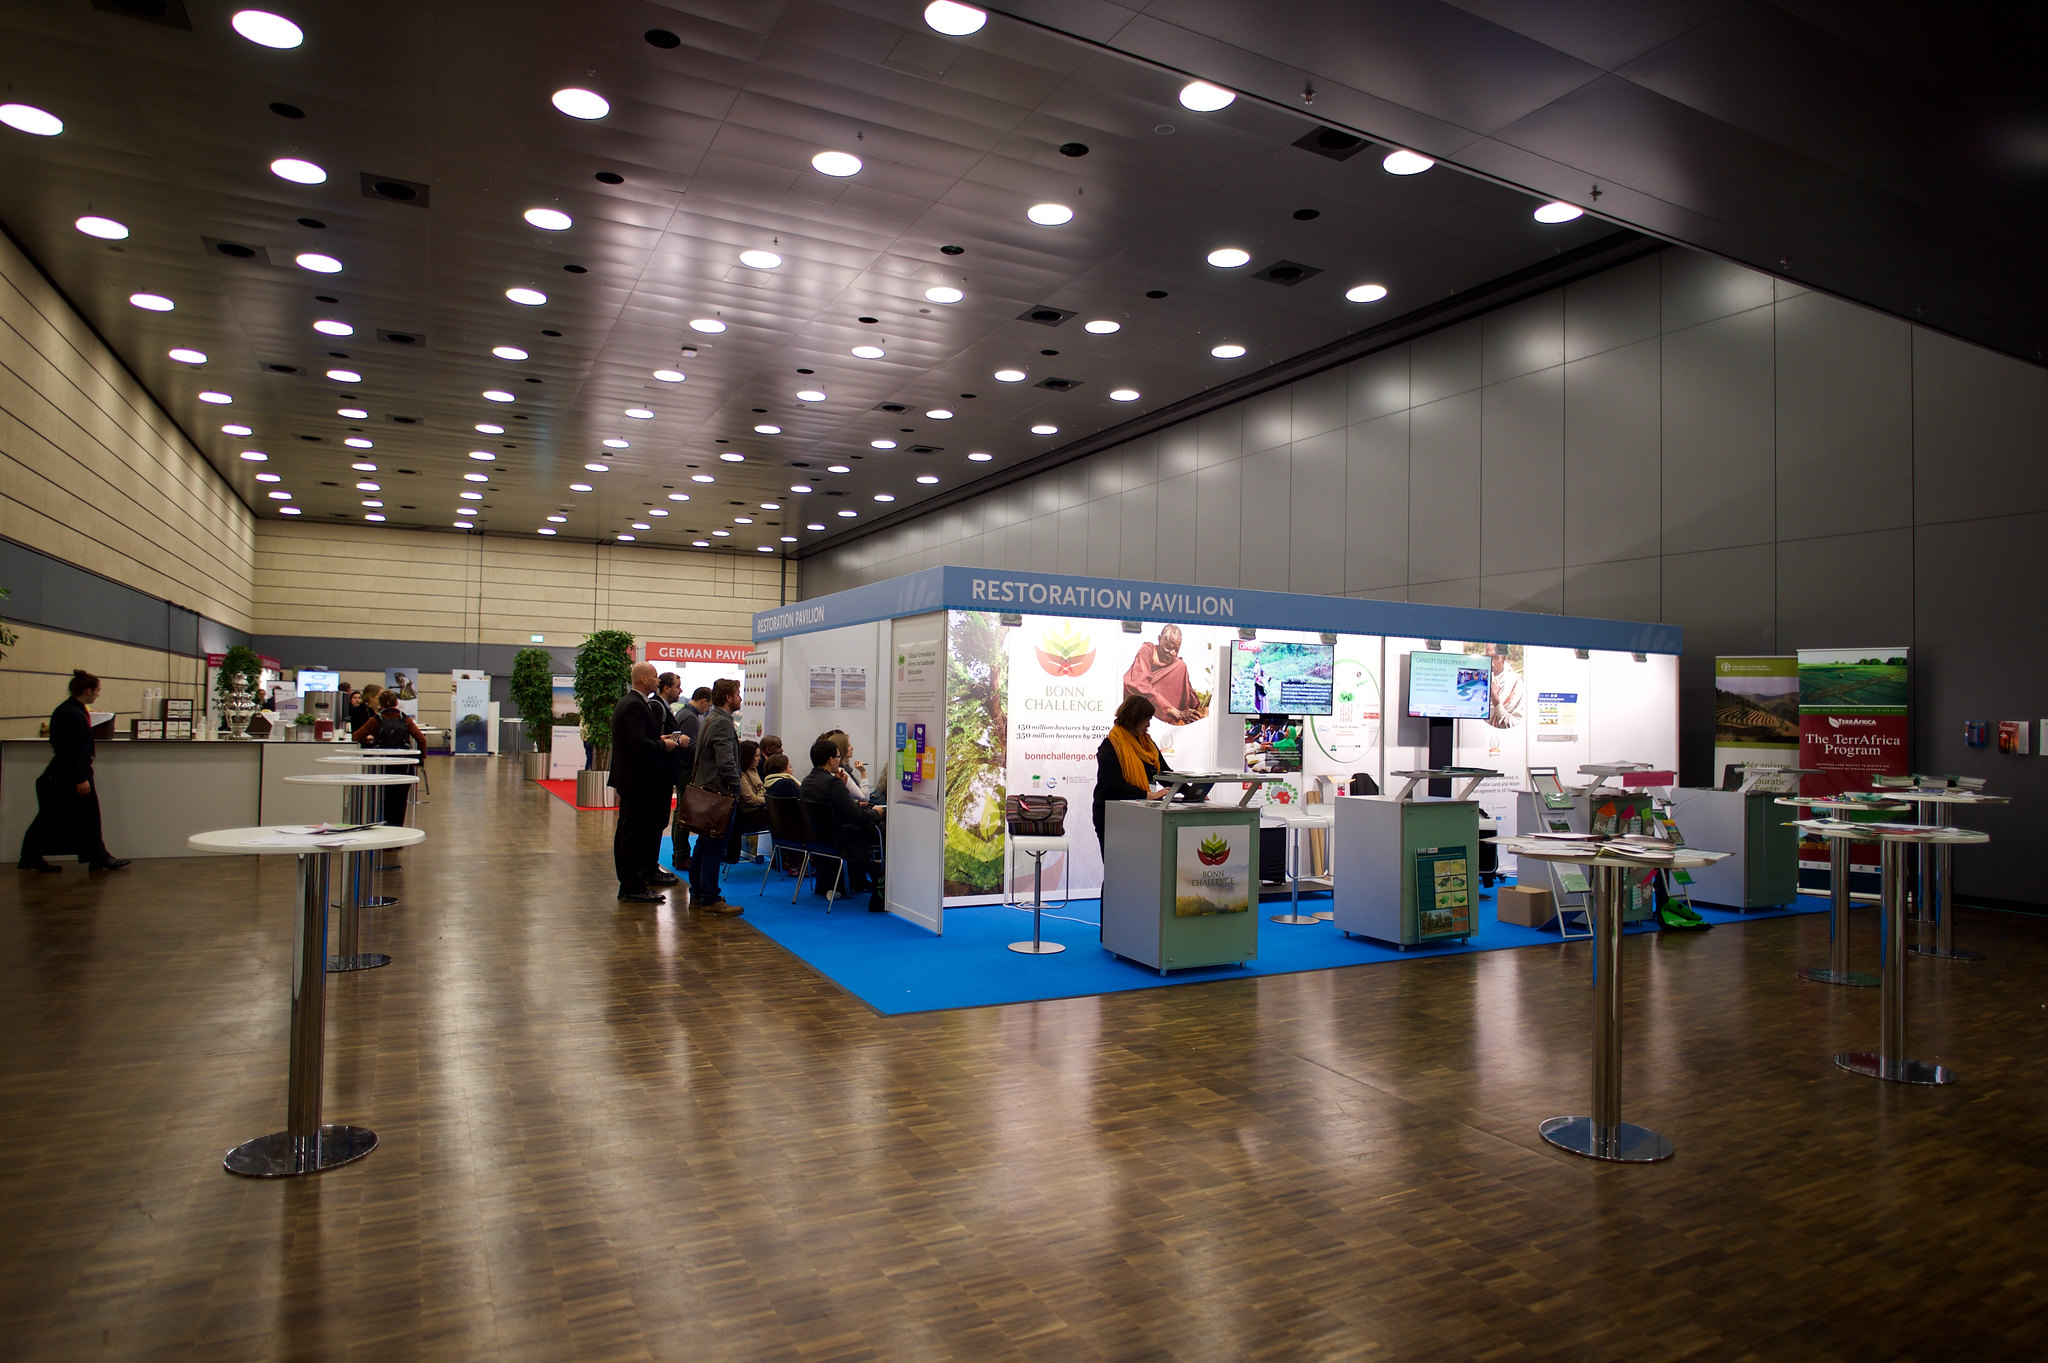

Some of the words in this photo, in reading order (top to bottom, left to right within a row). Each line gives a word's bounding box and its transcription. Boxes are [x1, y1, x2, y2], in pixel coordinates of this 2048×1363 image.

[971, 578, 1132, 610] RESTORATION
[1139, 590, 1234, 617] PAVILION
[757, 611, 795, 634] RESTORATION
[795, 605, 825, 627] PAVILION
[658, 647, 712, 659] GERMAN
[715, 649, 751, 660] PAVIL
[1437, 658, 1468, 666] DEVELOPMENT
[1045, 686, 1085, 698] BONN
[1024, 697, 1104, 712] CHALLENGE
[1016, 732, 1031, 740] 350
[1805, 733, 1829, 744] The
[1833, 734, 1900, 746] TerrAfrica
[1824, 743, 1881, 758] Program
[1024, 752, 1097, 762] bonnchallenge.or
[1202, 870, 1225, 878] BONN
[1191, 878, 1235, 887] CHALLENGE
